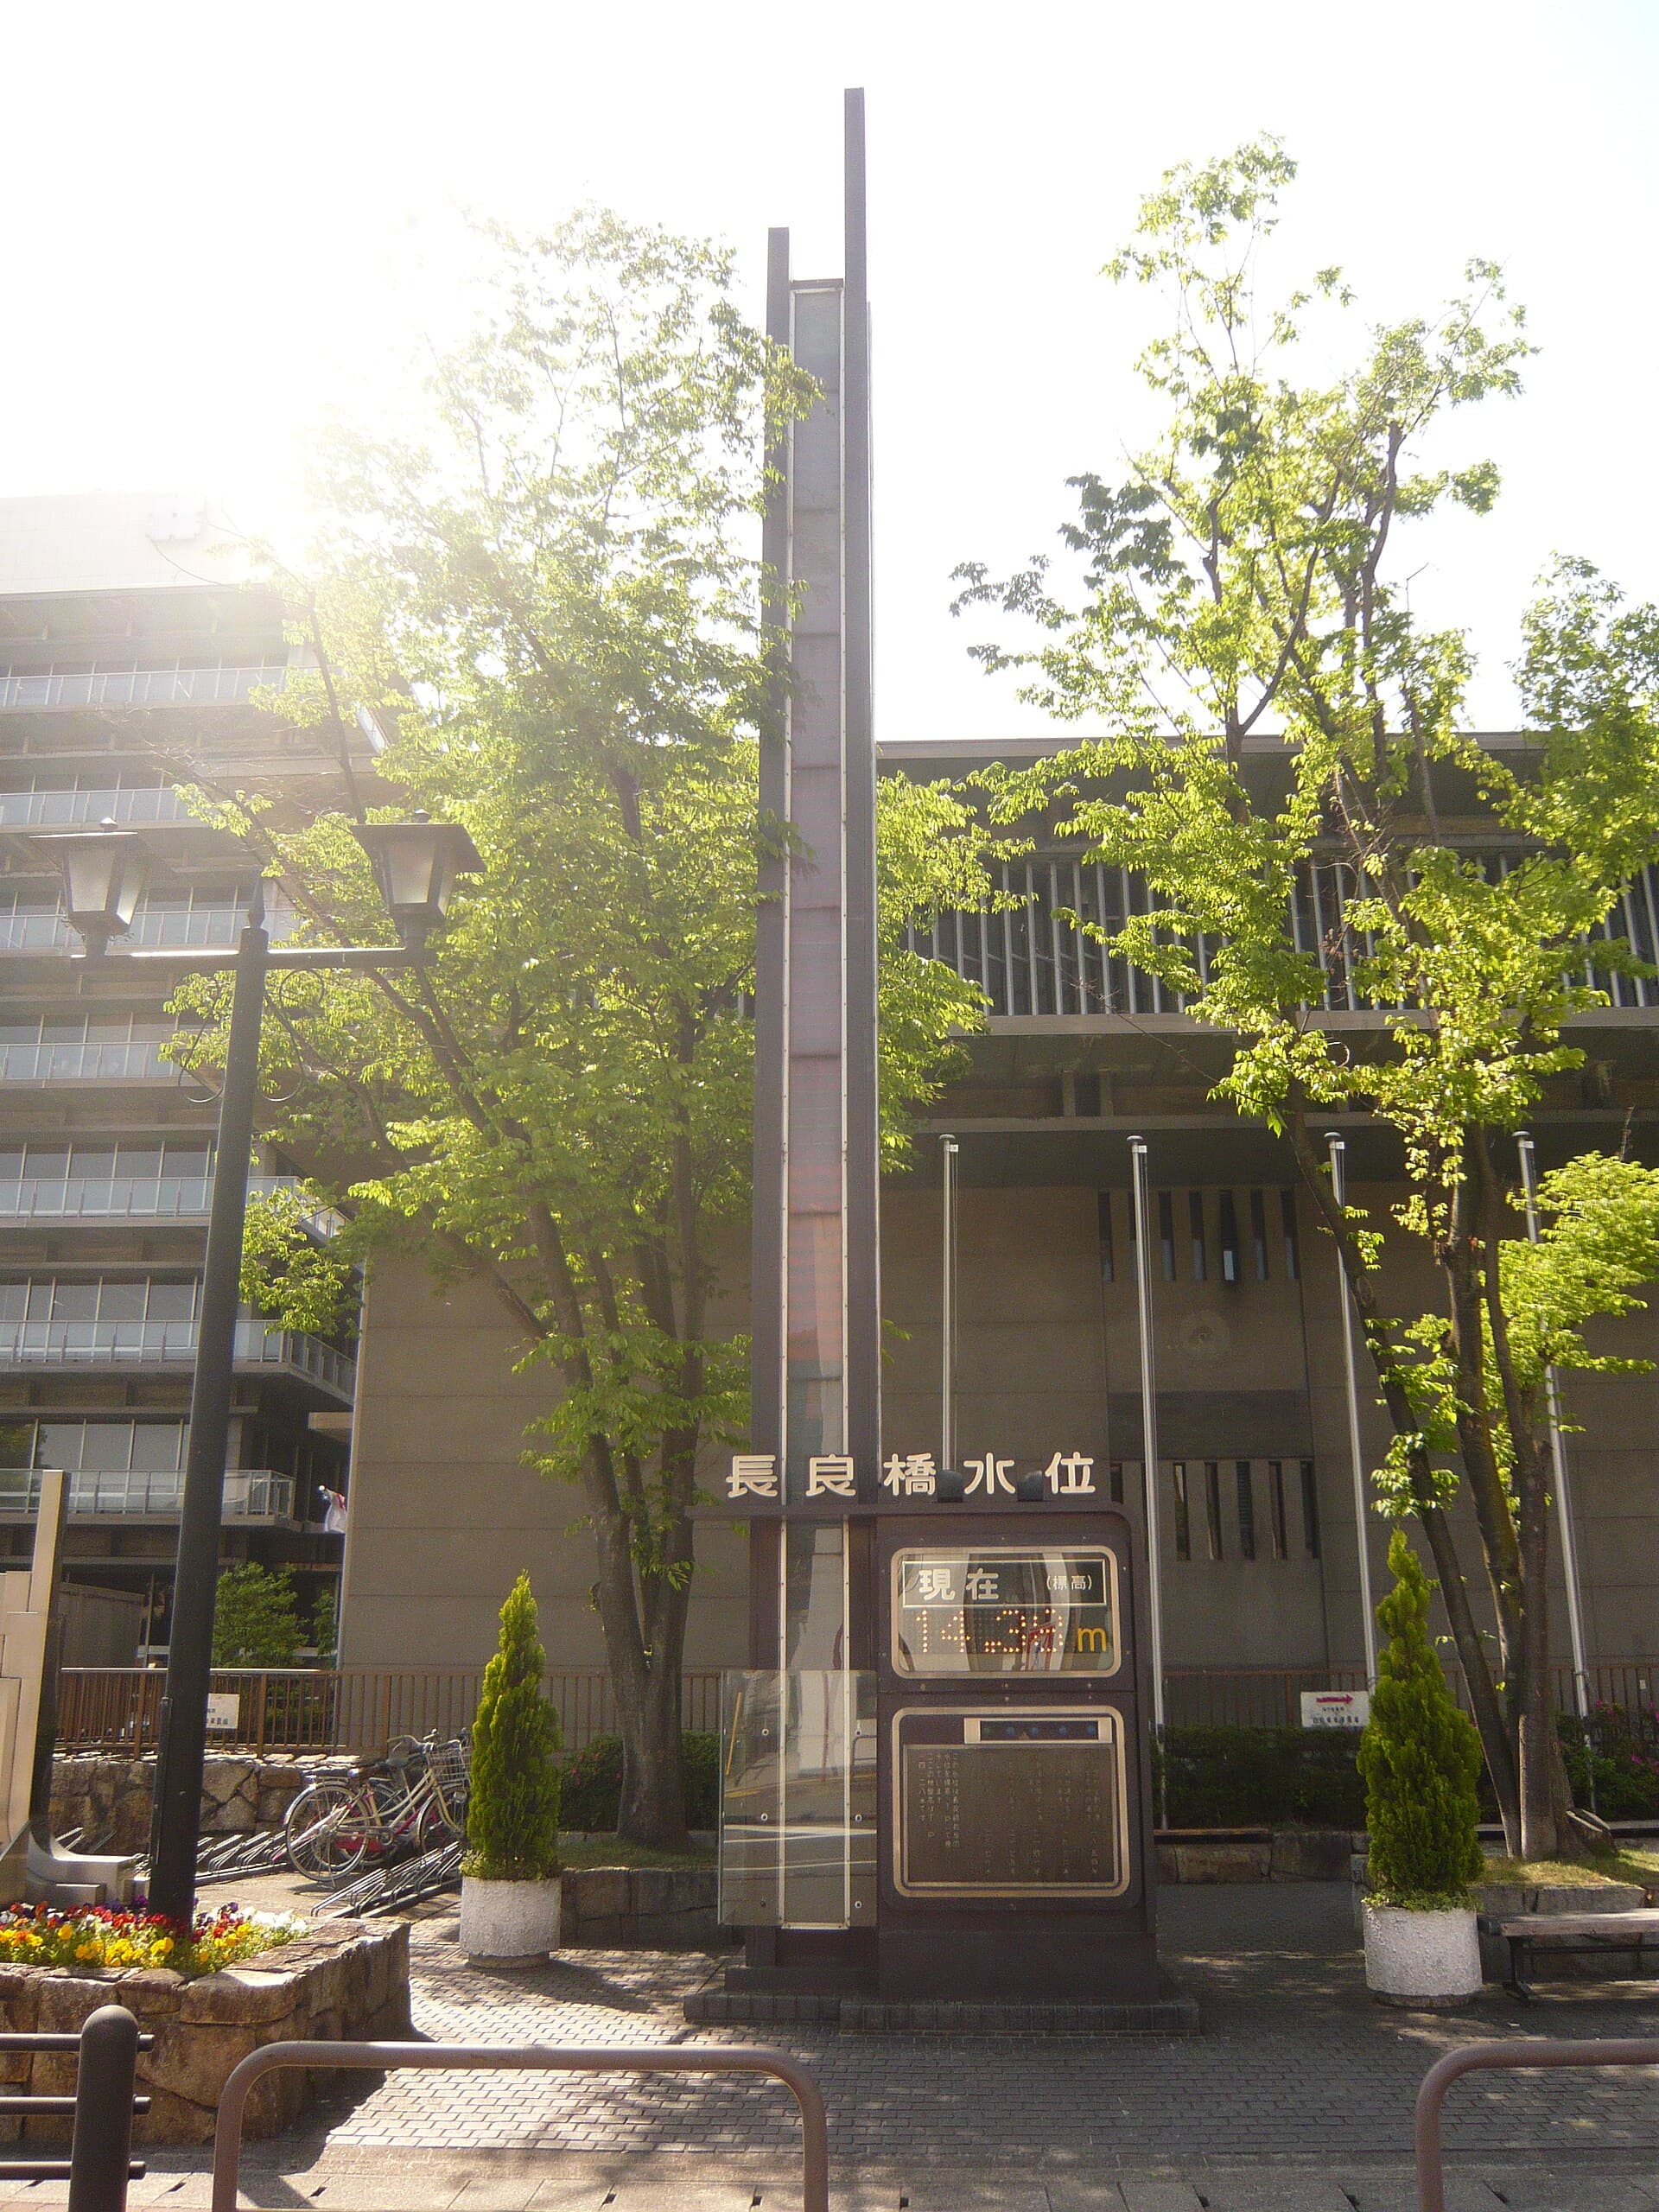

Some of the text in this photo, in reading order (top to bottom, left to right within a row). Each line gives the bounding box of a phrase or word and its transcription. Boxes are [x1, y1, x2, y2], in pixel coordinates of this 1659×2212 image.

[726, 1452, 1096, 1498] 長良橋水位
[918, 1567, 1000, 1601] 現在
[1077, 1626, 1107, 1652] m
